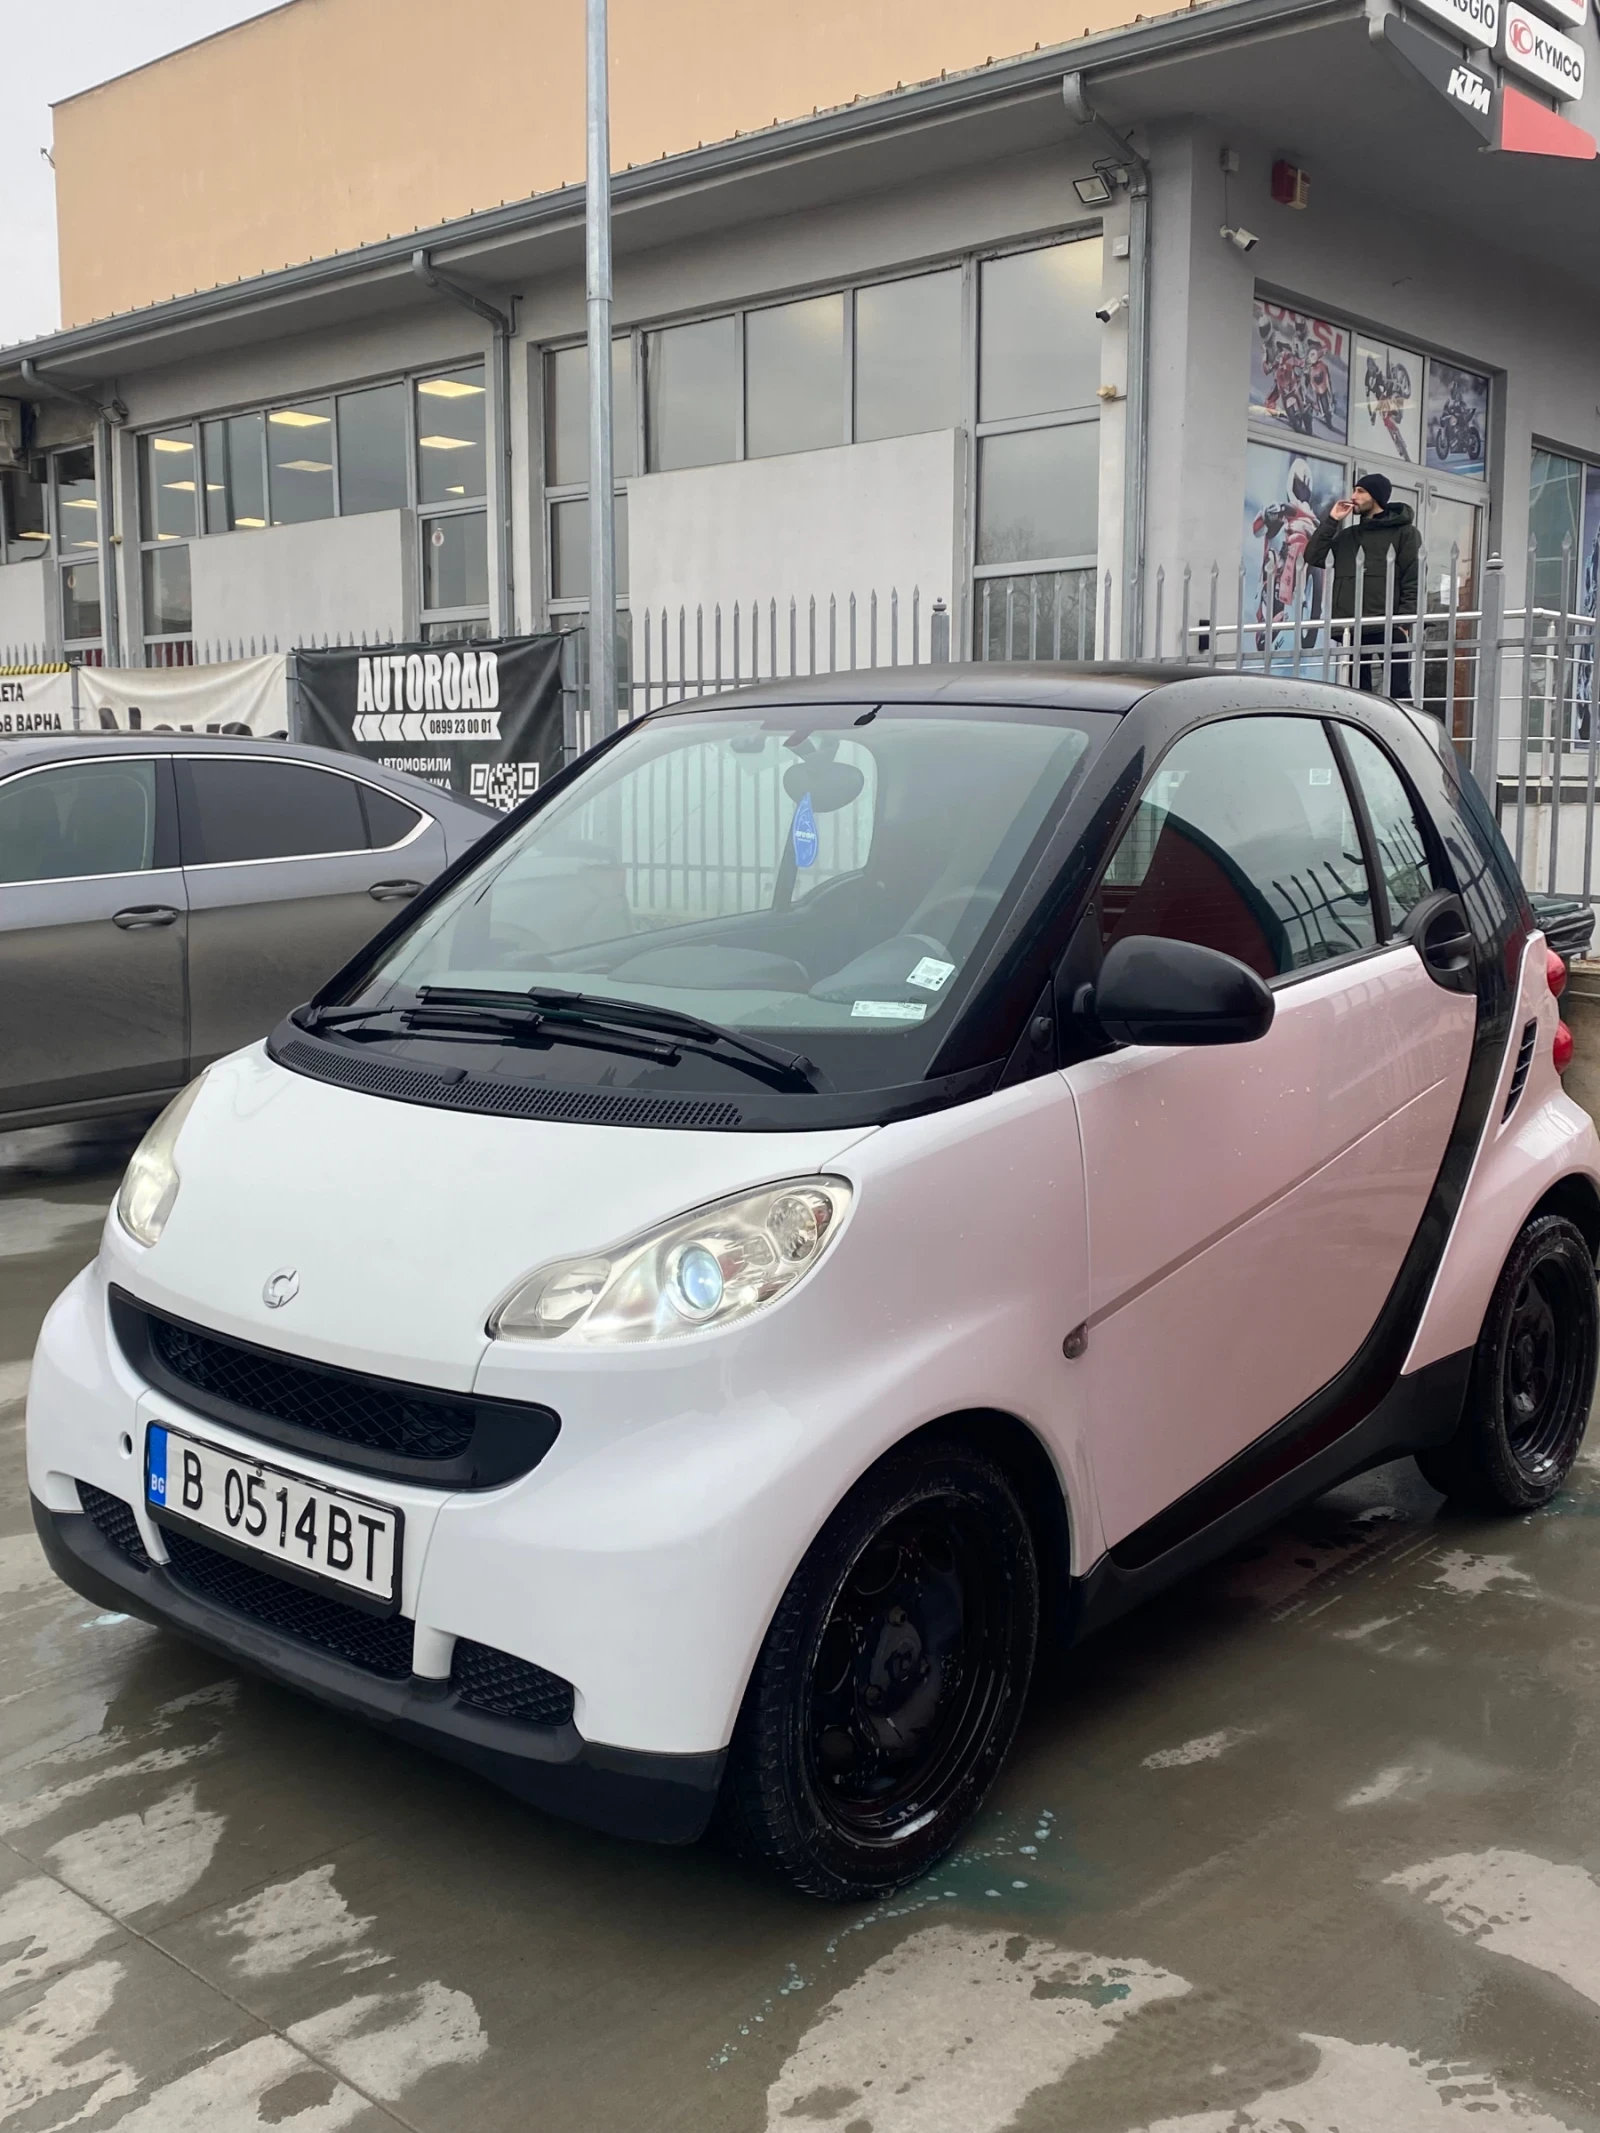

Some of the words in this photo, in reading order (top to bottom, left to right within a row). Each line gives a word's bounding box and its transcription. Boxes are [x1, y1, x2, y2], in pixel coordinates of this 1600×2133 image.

[1534, 36, 1581, 82] KYMCO
[1447, 65, 1491, 115] KTM
[0, 682, 25, 702] ЕТА
[356, 651, 500, 712] AUTOROAD
[16, 713, 62, 731] ВАРНА
[430, 719, 453, 734] 0899
[454, 719, 466, 734] 23
[467, 718, 480, 734] 00
[481, 718, 492, 734] 01
[151, 1473, 165, 1494] BG
[183, 1449, 203, 1510] B
[224, 1468, 386, 1582] 0514BT
